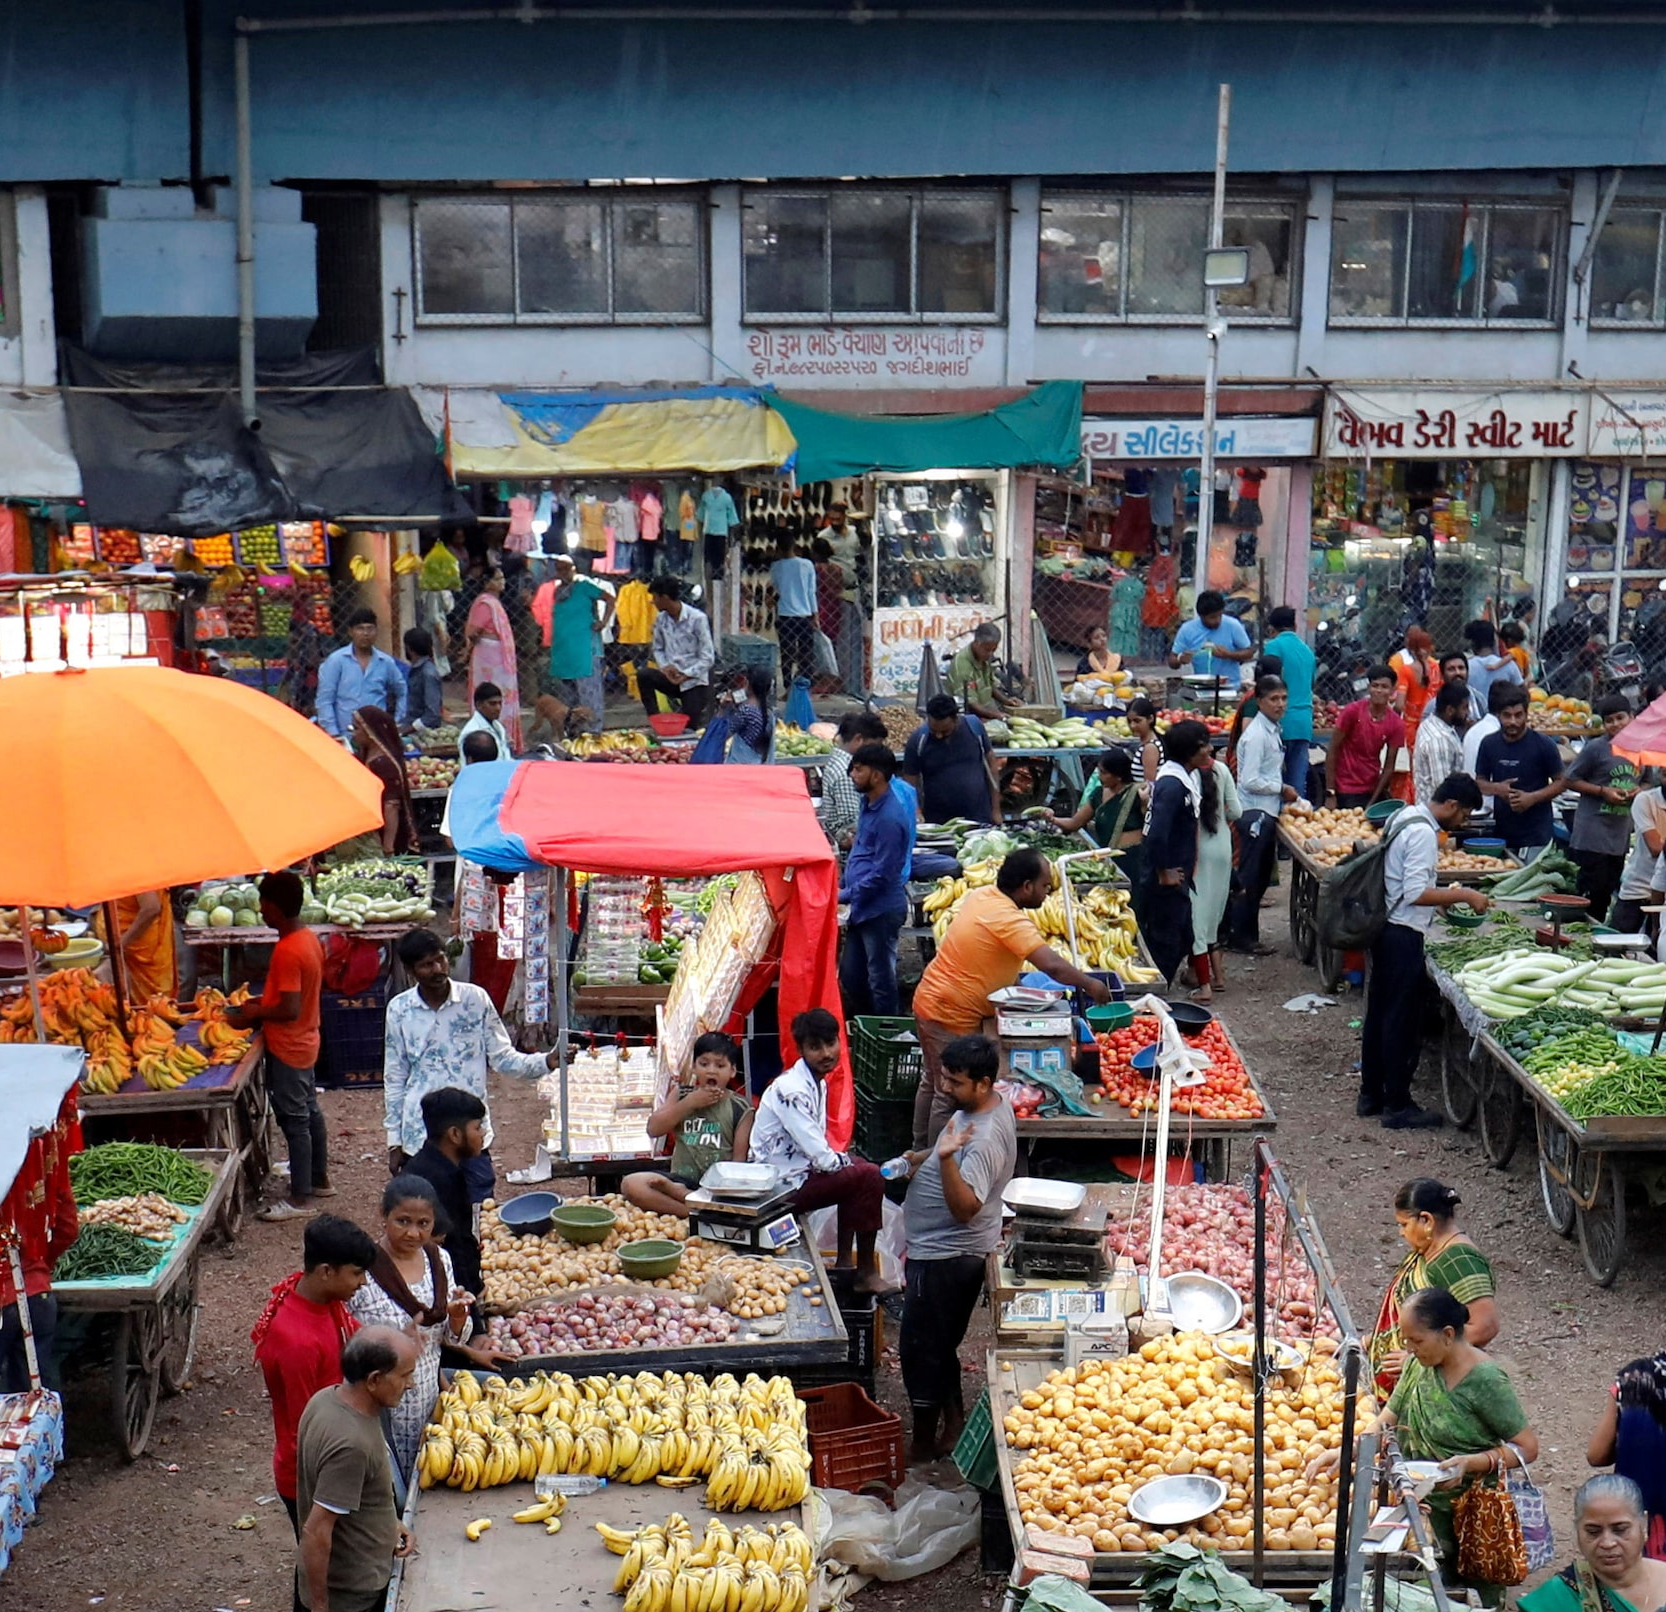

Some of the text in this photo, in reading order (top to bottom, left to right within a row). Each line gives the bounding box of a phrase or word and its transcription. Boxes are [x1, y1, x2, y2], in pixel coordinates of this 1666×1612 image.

[747, 328, 773, 357] શો
[885, 356, 972, 377] જગદીશભાઈ
[1414, 409, 1457, 448] ડેરી
[1466, 409, 1523, 448] સ્વીટ
[1532, 410, 1578, 448] માર્ટ
[1090, 1342, 1113, 1351] APC
